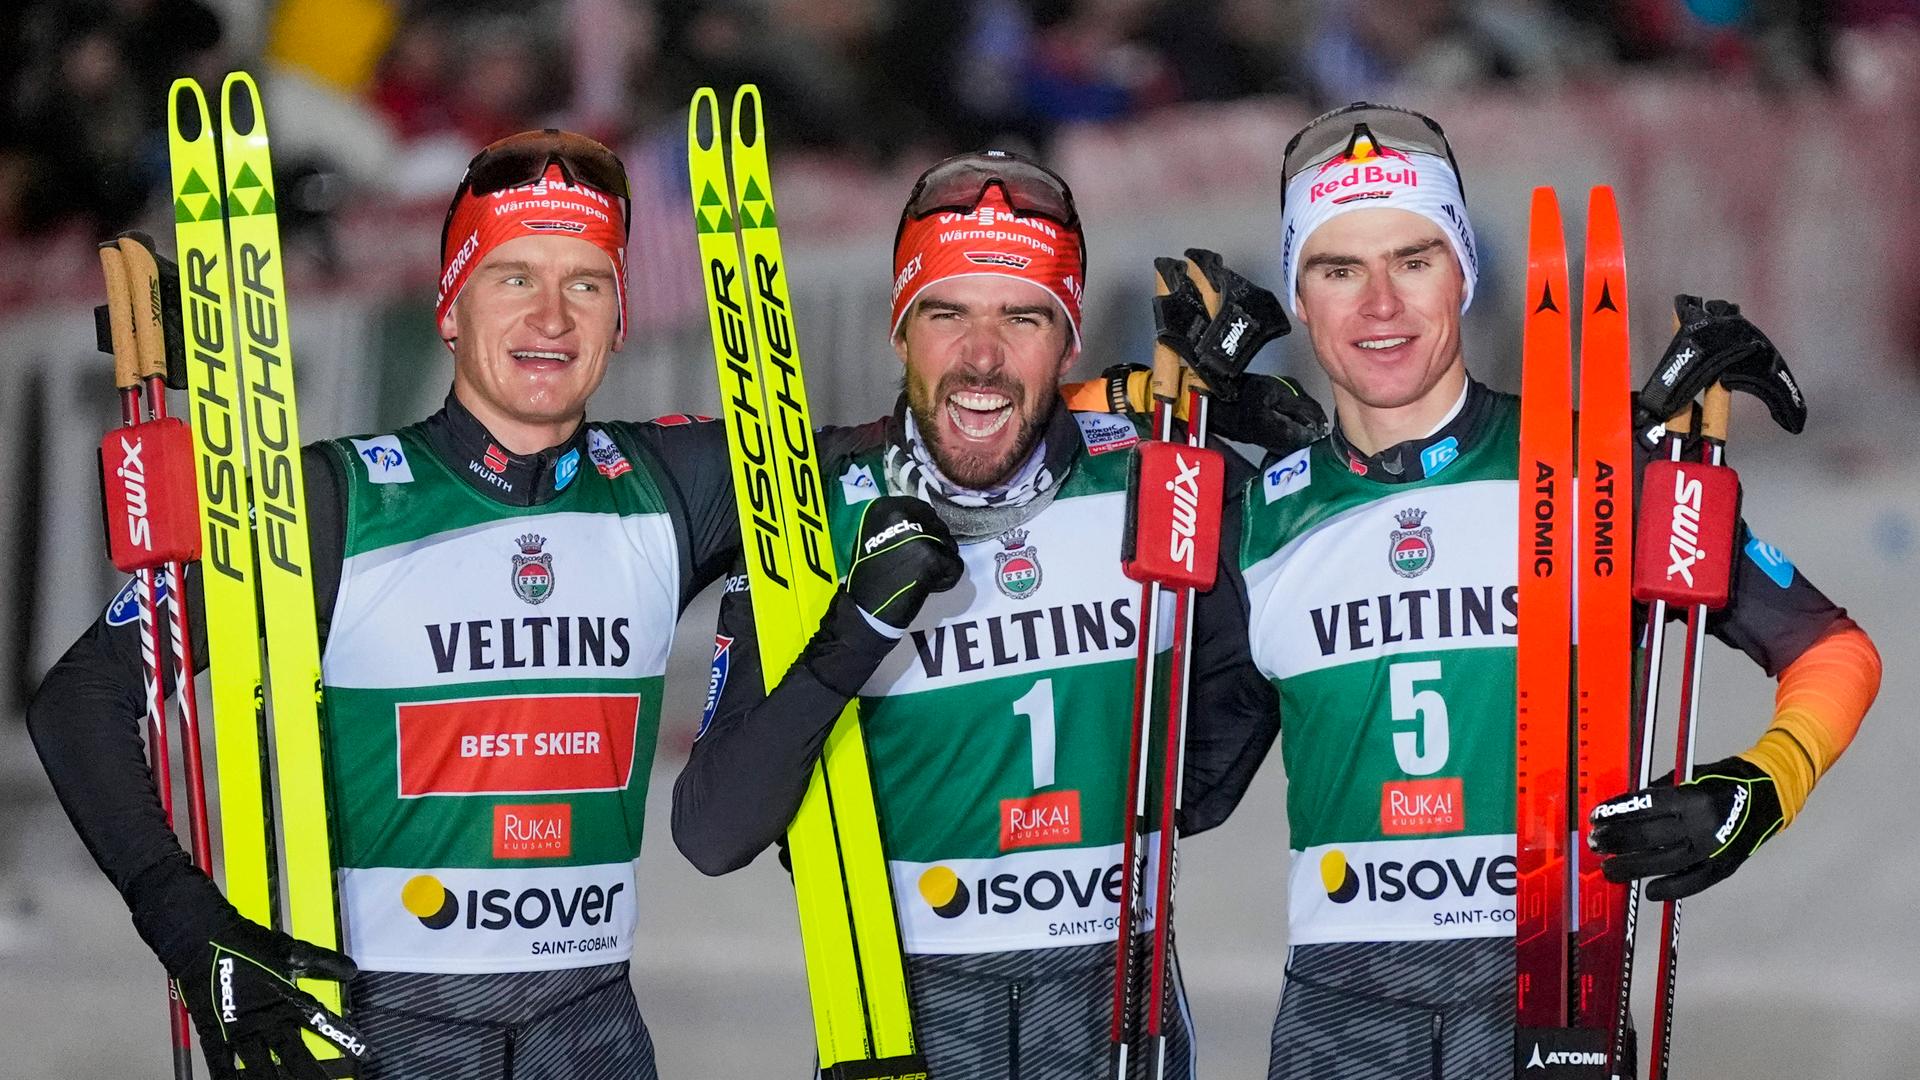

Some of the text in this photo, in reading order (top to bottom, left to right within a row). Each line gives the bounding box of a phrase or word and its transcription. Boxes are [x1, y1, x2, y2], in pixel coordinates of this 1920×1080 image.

[494, 199, 609, 223] Wärmepumpen
[1310, 166, 1417, 204] Red Bull
[440, 229, 480, 294] TERREX
[939, 229, 1055, 256] Wärmepumpen
[186, 247, 244, 583] FISCHER
[240, 242, 302, 577] FISCHER
[711, 258, 789, 590] FISCHER
[754, 253, 833, 585] FISCHER
[468, 460, 512, 493] WÜRTH
[1534, 460, 1554, 578] ATOMIC
[1593, 460, 1614, 578] ATOMIC
[425, 616, 631, 674] VELTINS
[910, 598, 1137, 679] VELTINS
[1310, 585, 1518, 657] VELTINS
[460, 732, 600, 758] BEST SKIER
[1012, 678, 1056, 790] 1
[1389, 660, 1450, 776] 5
[504, 841, 561, 850] KUUSAMO
[1010, 827, 1071, 841] KUUSAMO
[1392, 816, 1453, 826] KUUSAMO
[531, 935, 618, 955] SAINT-GOBAIN
